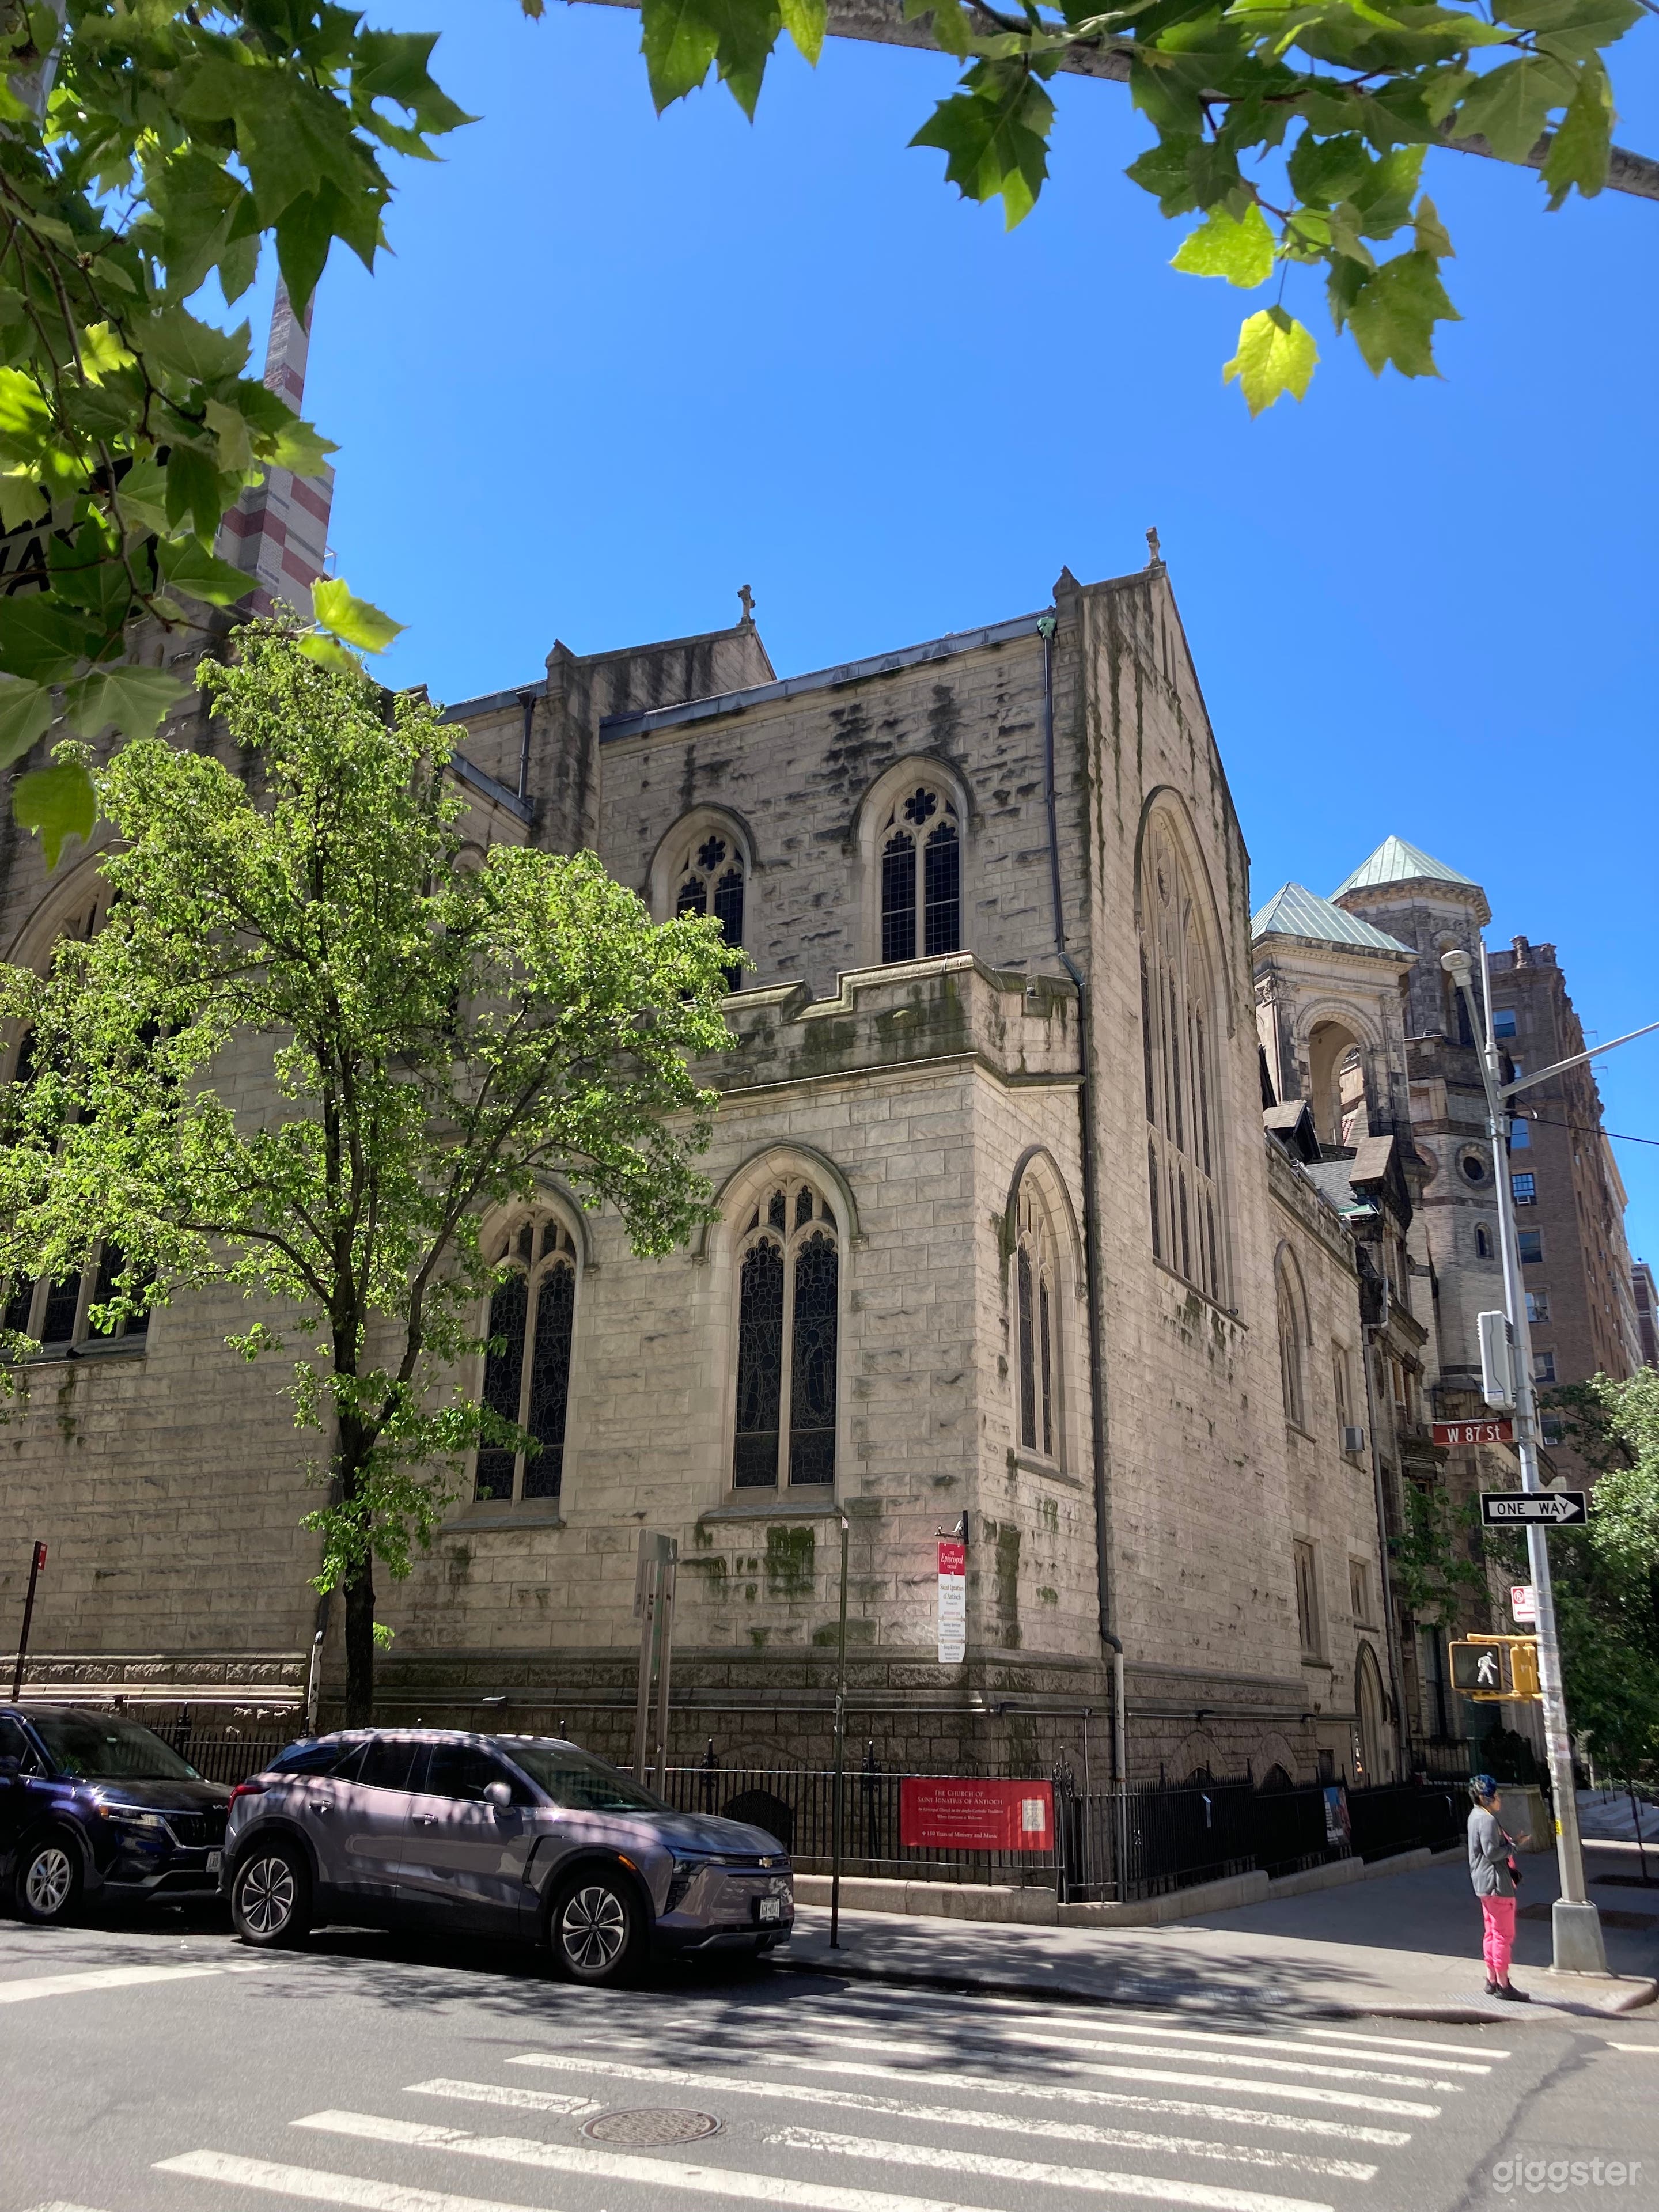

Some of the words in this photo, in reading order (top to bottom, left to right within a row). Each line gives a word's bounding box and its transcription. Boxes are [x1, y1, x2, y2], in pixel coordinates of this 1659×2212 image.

[1447, 1427, 1459, 1442] W
[1465, 1426, 1480, 1442] 87
[1486, 1425, 1501, 1440] St
[1497, 1502, 1525, 1515] ONE
[1539, 1502, 1568, 1514] WAY
[941, 1552, 963, 1566] Episcopal
